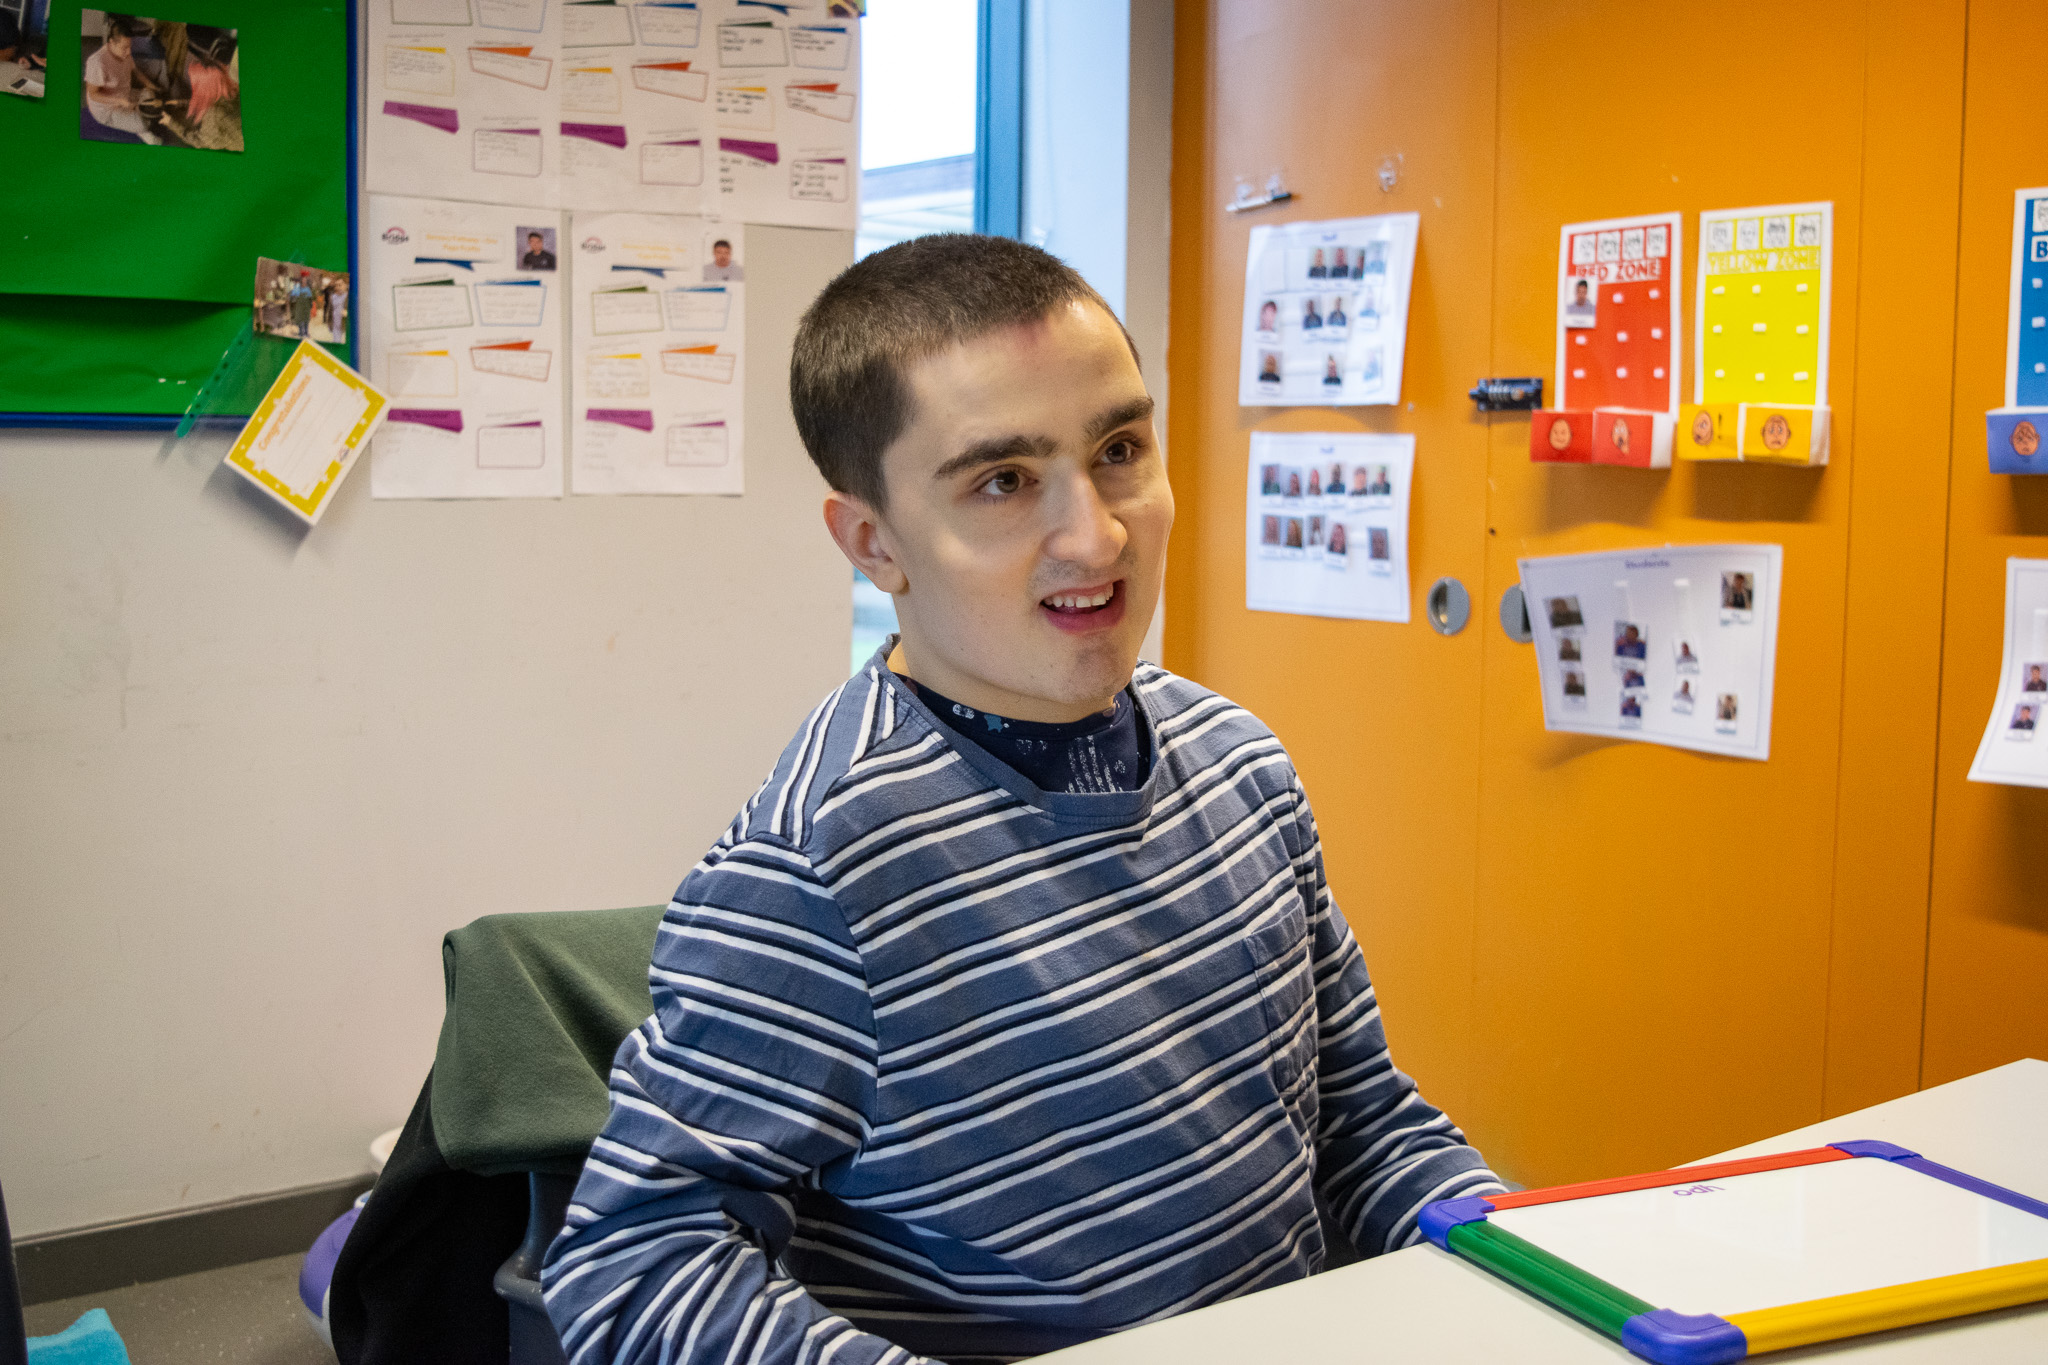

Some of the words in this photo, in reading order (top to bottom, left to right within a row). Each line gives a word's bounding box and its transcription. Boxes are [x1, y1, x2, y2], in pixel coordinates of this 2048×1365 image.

[1616, 261, 1659, 280] ZONE
[1708, 253, 1768, 273] YELLOW
[1776, 250, 1820, 270] ZONE
[258, 375, 312, 450] Congratulations
